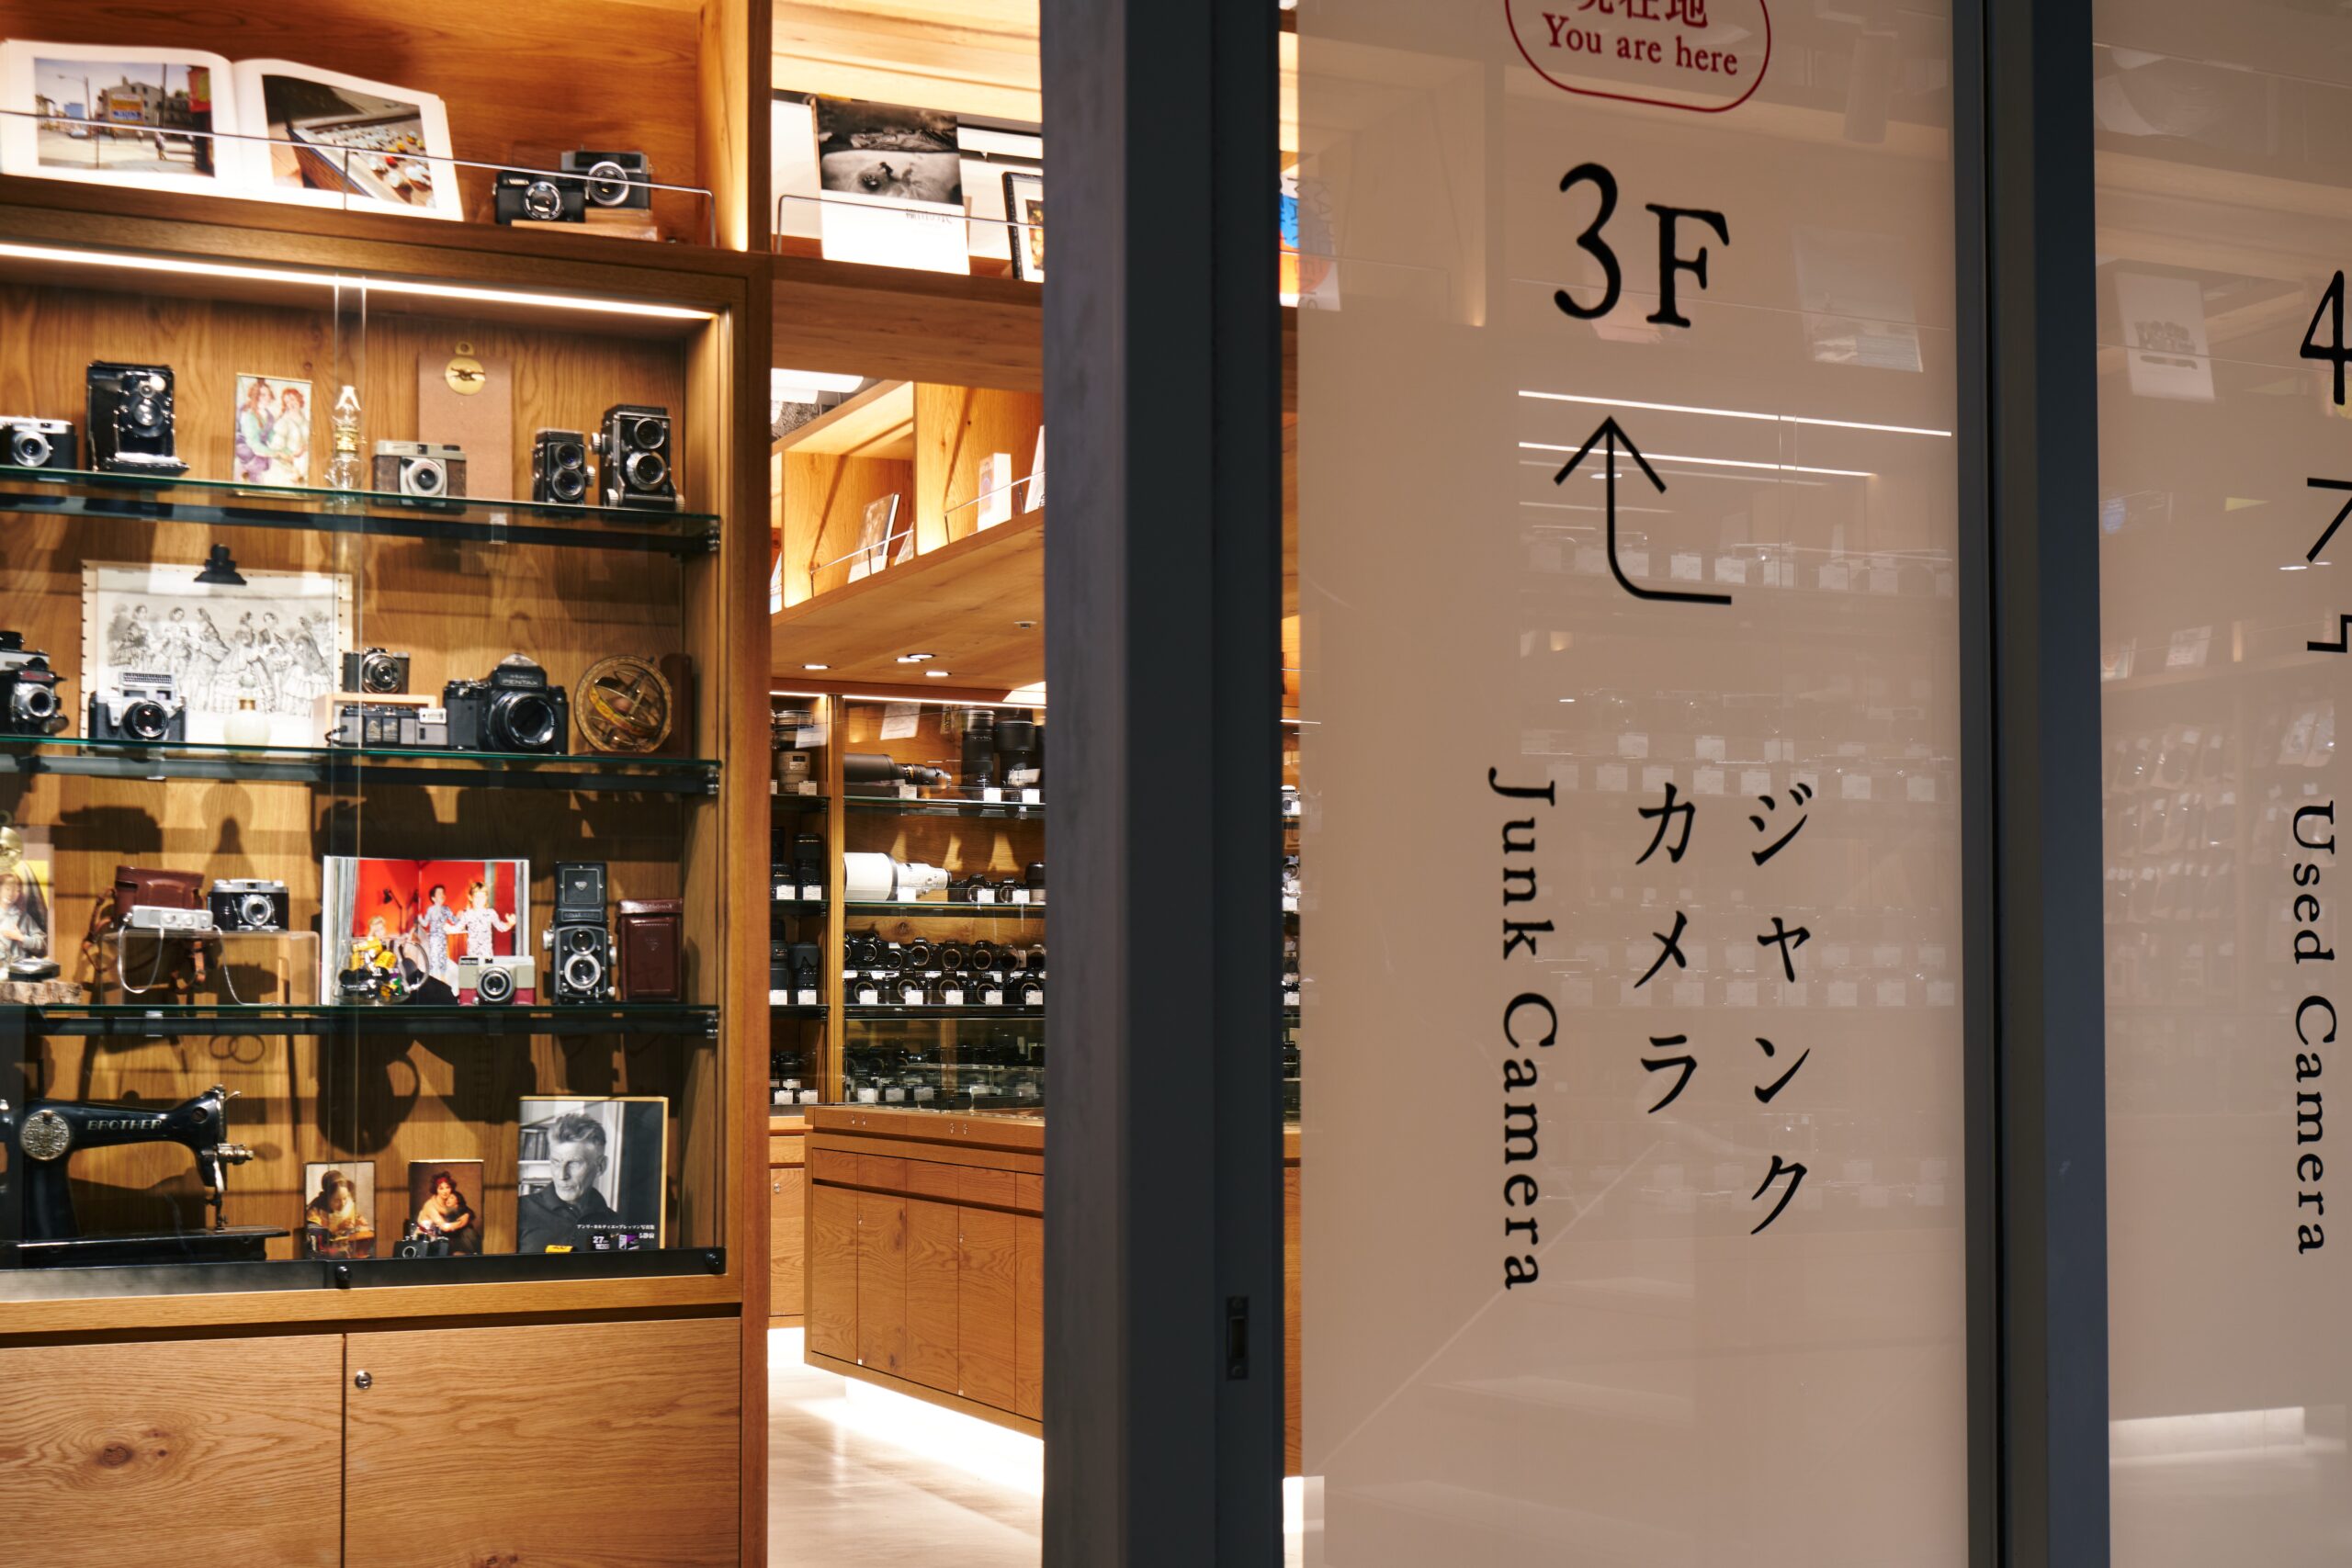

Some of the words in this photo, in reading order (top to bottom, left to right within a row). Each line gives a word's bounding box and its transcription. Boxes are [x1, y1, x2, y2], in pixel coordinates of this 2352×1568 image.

[1542, 12, 1602, 54] You
[1616, 36, 1662, 63] are
[1675, 34, 1738, 75] here
[1555, 164, 1730, 329] 3F
[1488, 767, 1555, 960] Junk
[1634, 783, 1698, 1114] カメラ
[2292, 800, 2335, 964] Used
[1749, 783, 1813, 1235] ジャンク
[87, 1120, 163, 1131] BROTHER
[1503, 992, 1558, 1290] Camera
[2295, 995, 2337, 1255] Camera
